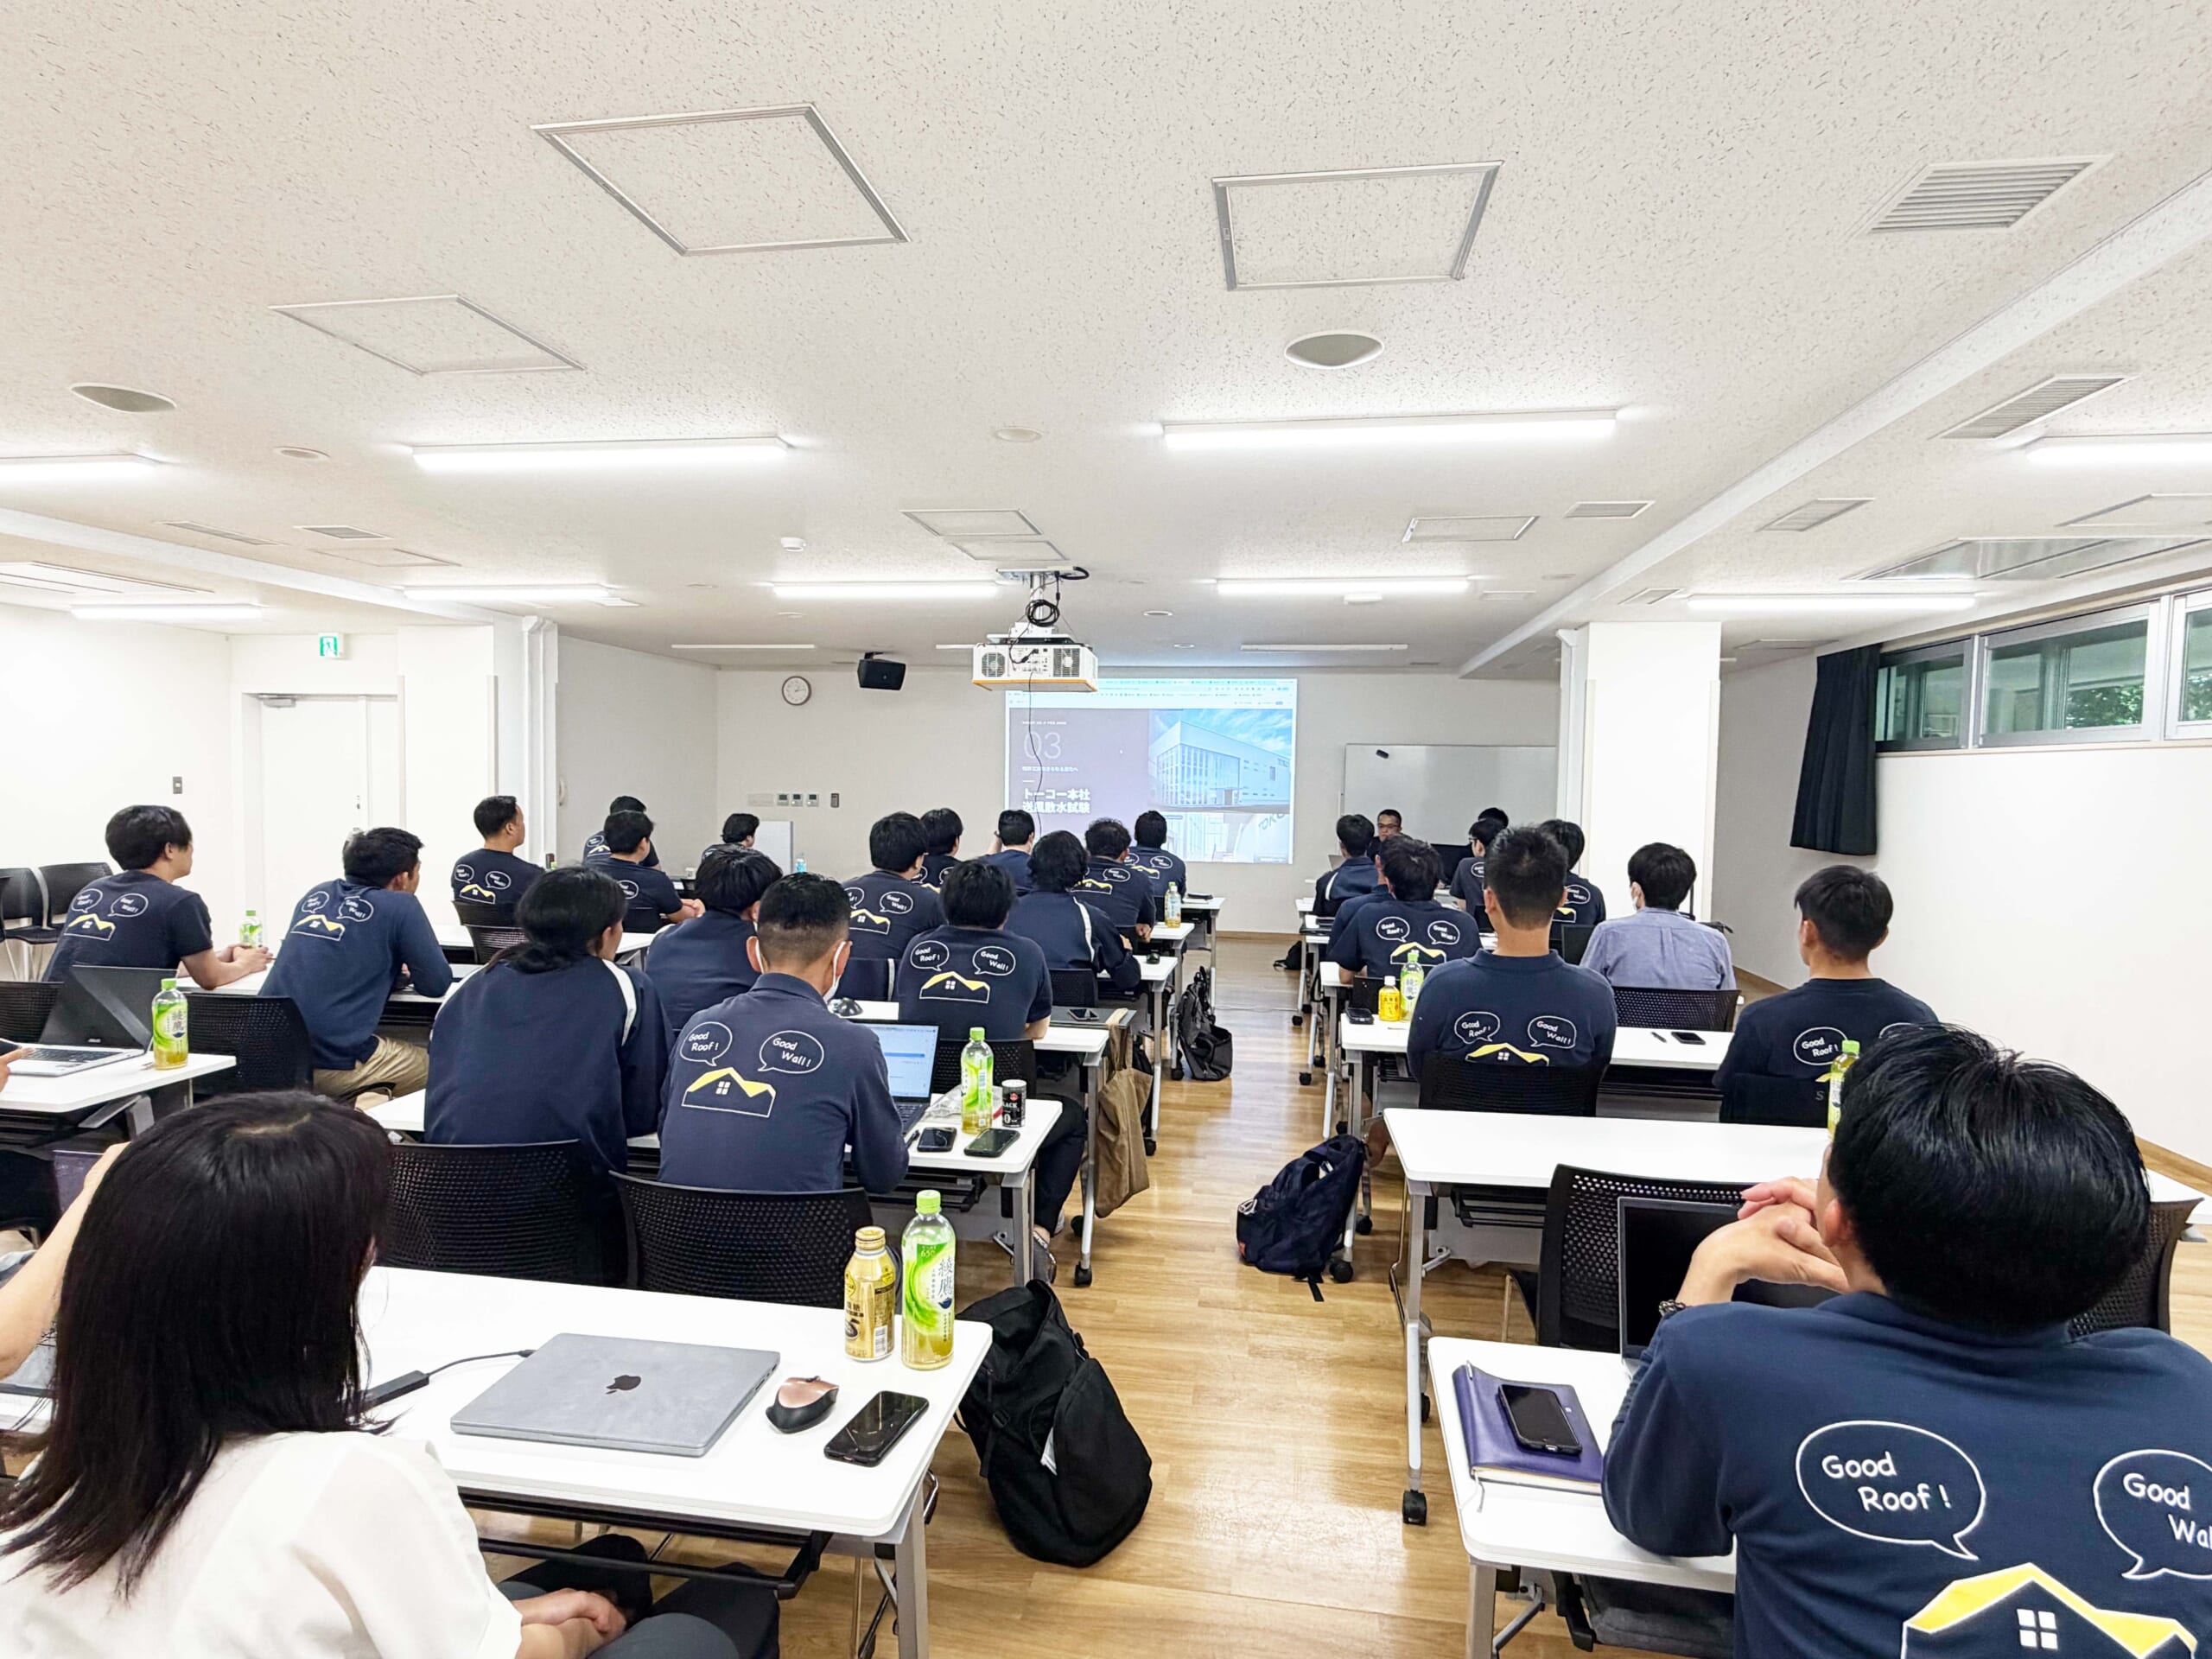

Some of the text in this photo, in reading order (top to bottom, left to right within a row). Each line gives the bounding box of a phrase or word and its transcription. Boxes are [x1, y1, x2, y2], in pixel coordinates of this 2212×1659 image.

[1024, 732, 1061, 759] 03
[1024, 787, 1090, 801] トーコー本社
[1461, 1020, 1480, 1029] Good
[1536, 1020, 1559, 1032] Good
[772, 1037, 798, 1051] Good
[1802, 1037, 1825, 1050] Good
[1812, 1043, 1840, 1057] Roof!
[781, 1050, 812, 1068] Wall!
[1821, 1451, 1897, 1478] Good
[2123, 1472, 2191, 1510] Good
